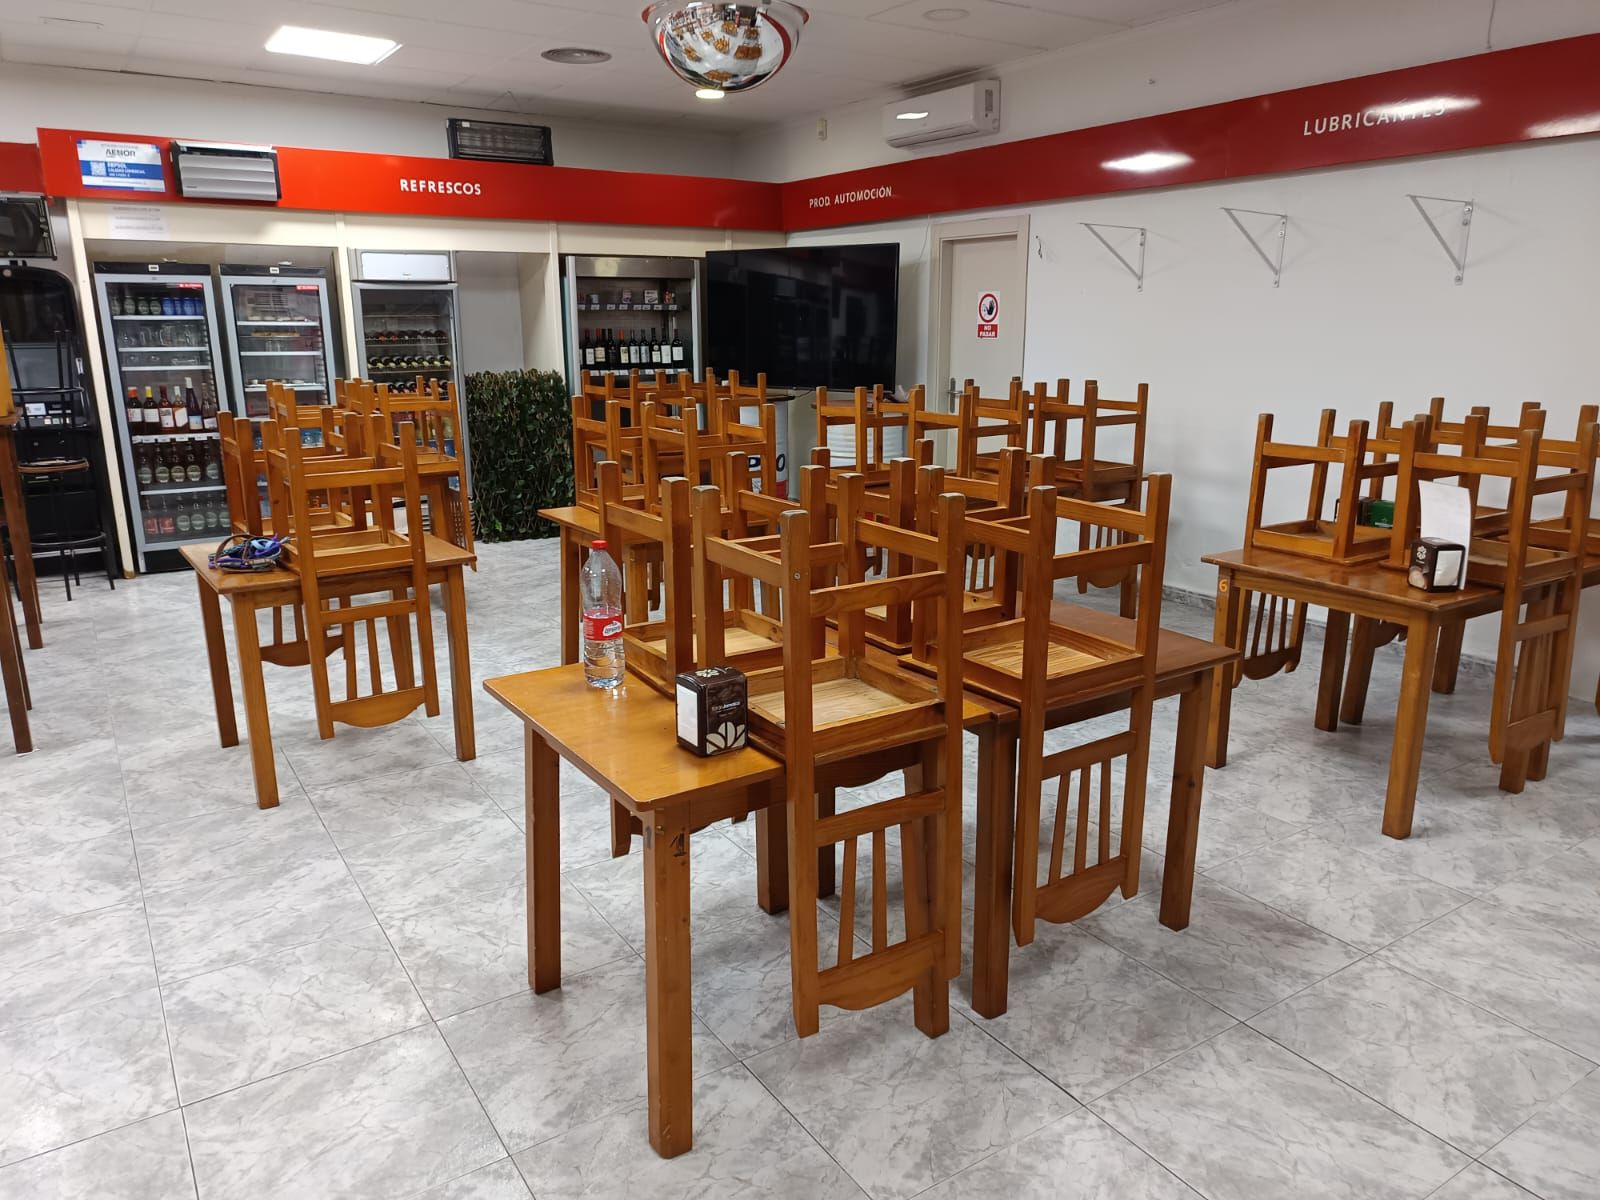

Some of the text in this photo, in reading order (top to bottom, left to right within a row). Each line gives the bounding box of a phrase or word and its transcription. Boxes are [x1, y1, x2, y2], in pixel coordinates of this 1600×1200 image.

[400, 179, 481, 195] REFRESCOS
[834, 186, 892, 205] AUTOMOCIÓN
[1219, 579, 1228, 593] 6
